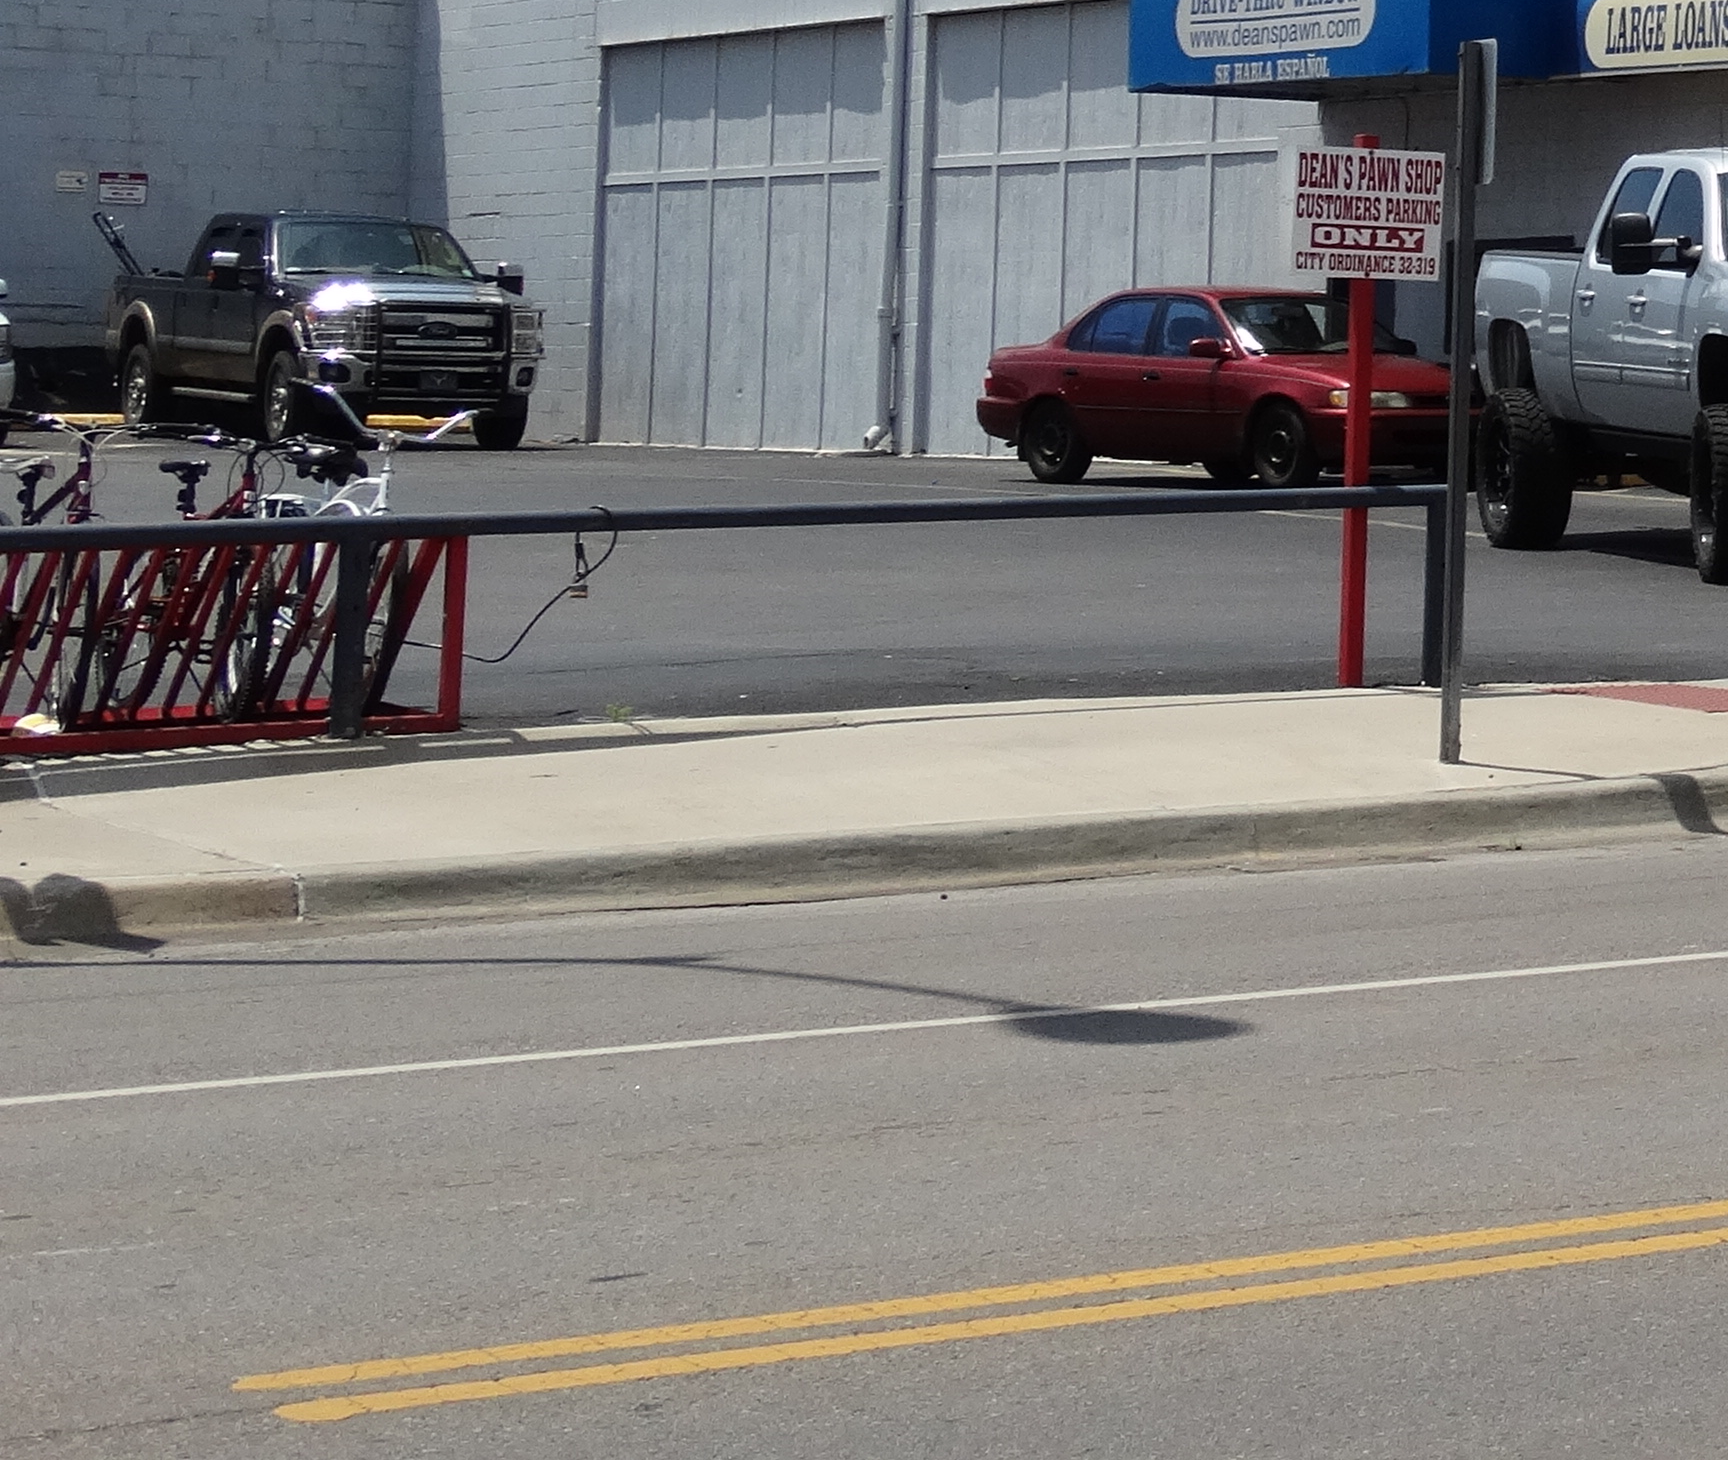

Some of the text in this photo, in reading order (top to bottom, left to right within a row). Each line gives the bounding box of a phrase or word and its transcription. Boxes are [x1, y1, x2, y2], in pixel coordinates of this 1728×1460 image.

[1190, 16, 1361, 48] www.deanspawn.com
[1605, 4, 1668, 55] LARGE
[1215, 53, 1330, 84] SE HABLA ESPAÑOL
[1298, 152, 1443, 195] DEAN'S PAWN SHOP
[1296, 193, 1440, 225] CUSTOMERS PARKING
[1314, 226, 1424, 249] ONLY
[1296, 251, 1436, 275] CITY ORDINANCE 32-319
